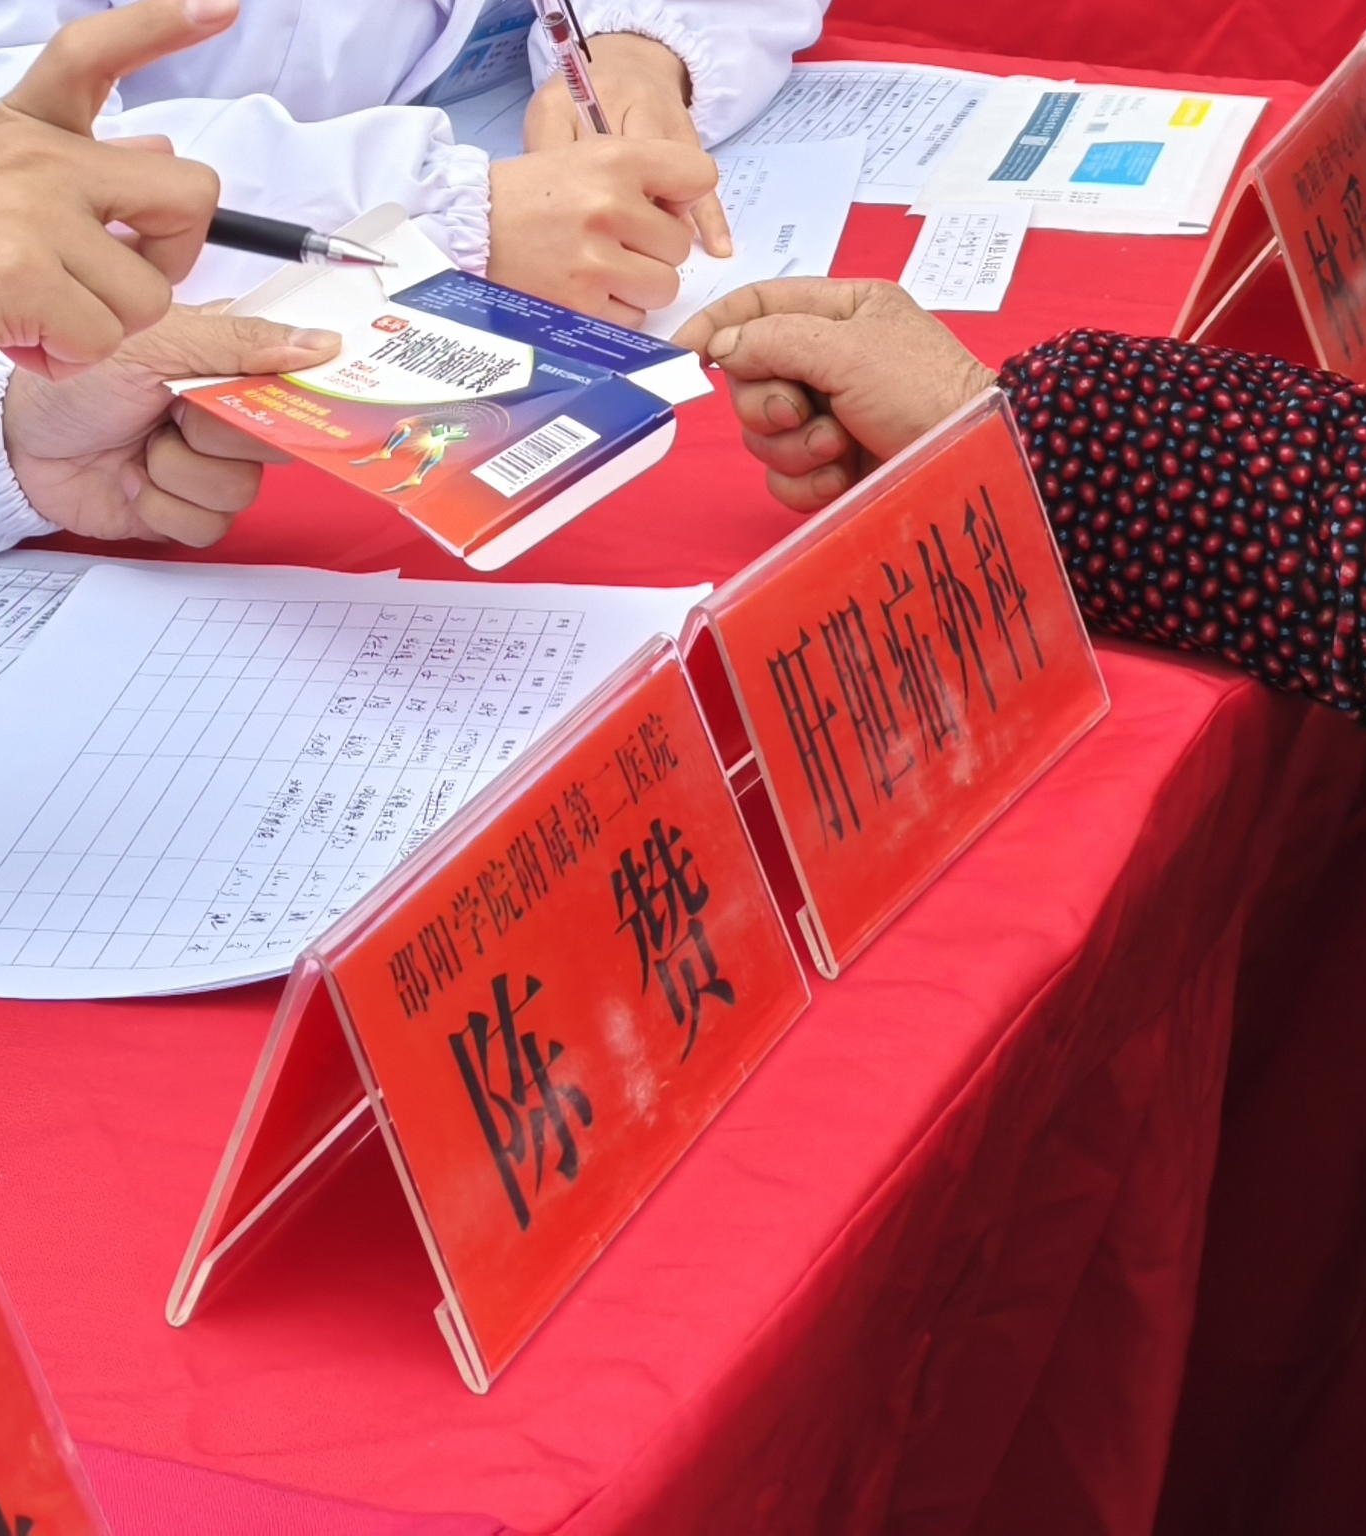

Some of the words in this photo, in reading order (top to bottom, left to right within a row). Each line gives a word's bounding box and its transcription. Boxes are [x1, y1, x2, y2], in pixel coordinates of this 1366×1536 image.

[369, 327, 521, 393] 骨刺消痛胶囊
[766, 485, 1044, 851] 肝胆疝外科
[387, 711, 679, 1021] 邵阳学院附属第二医院
[449, 973, 593, 1232] 陈
[611, 818, 735, 1064] 赞
